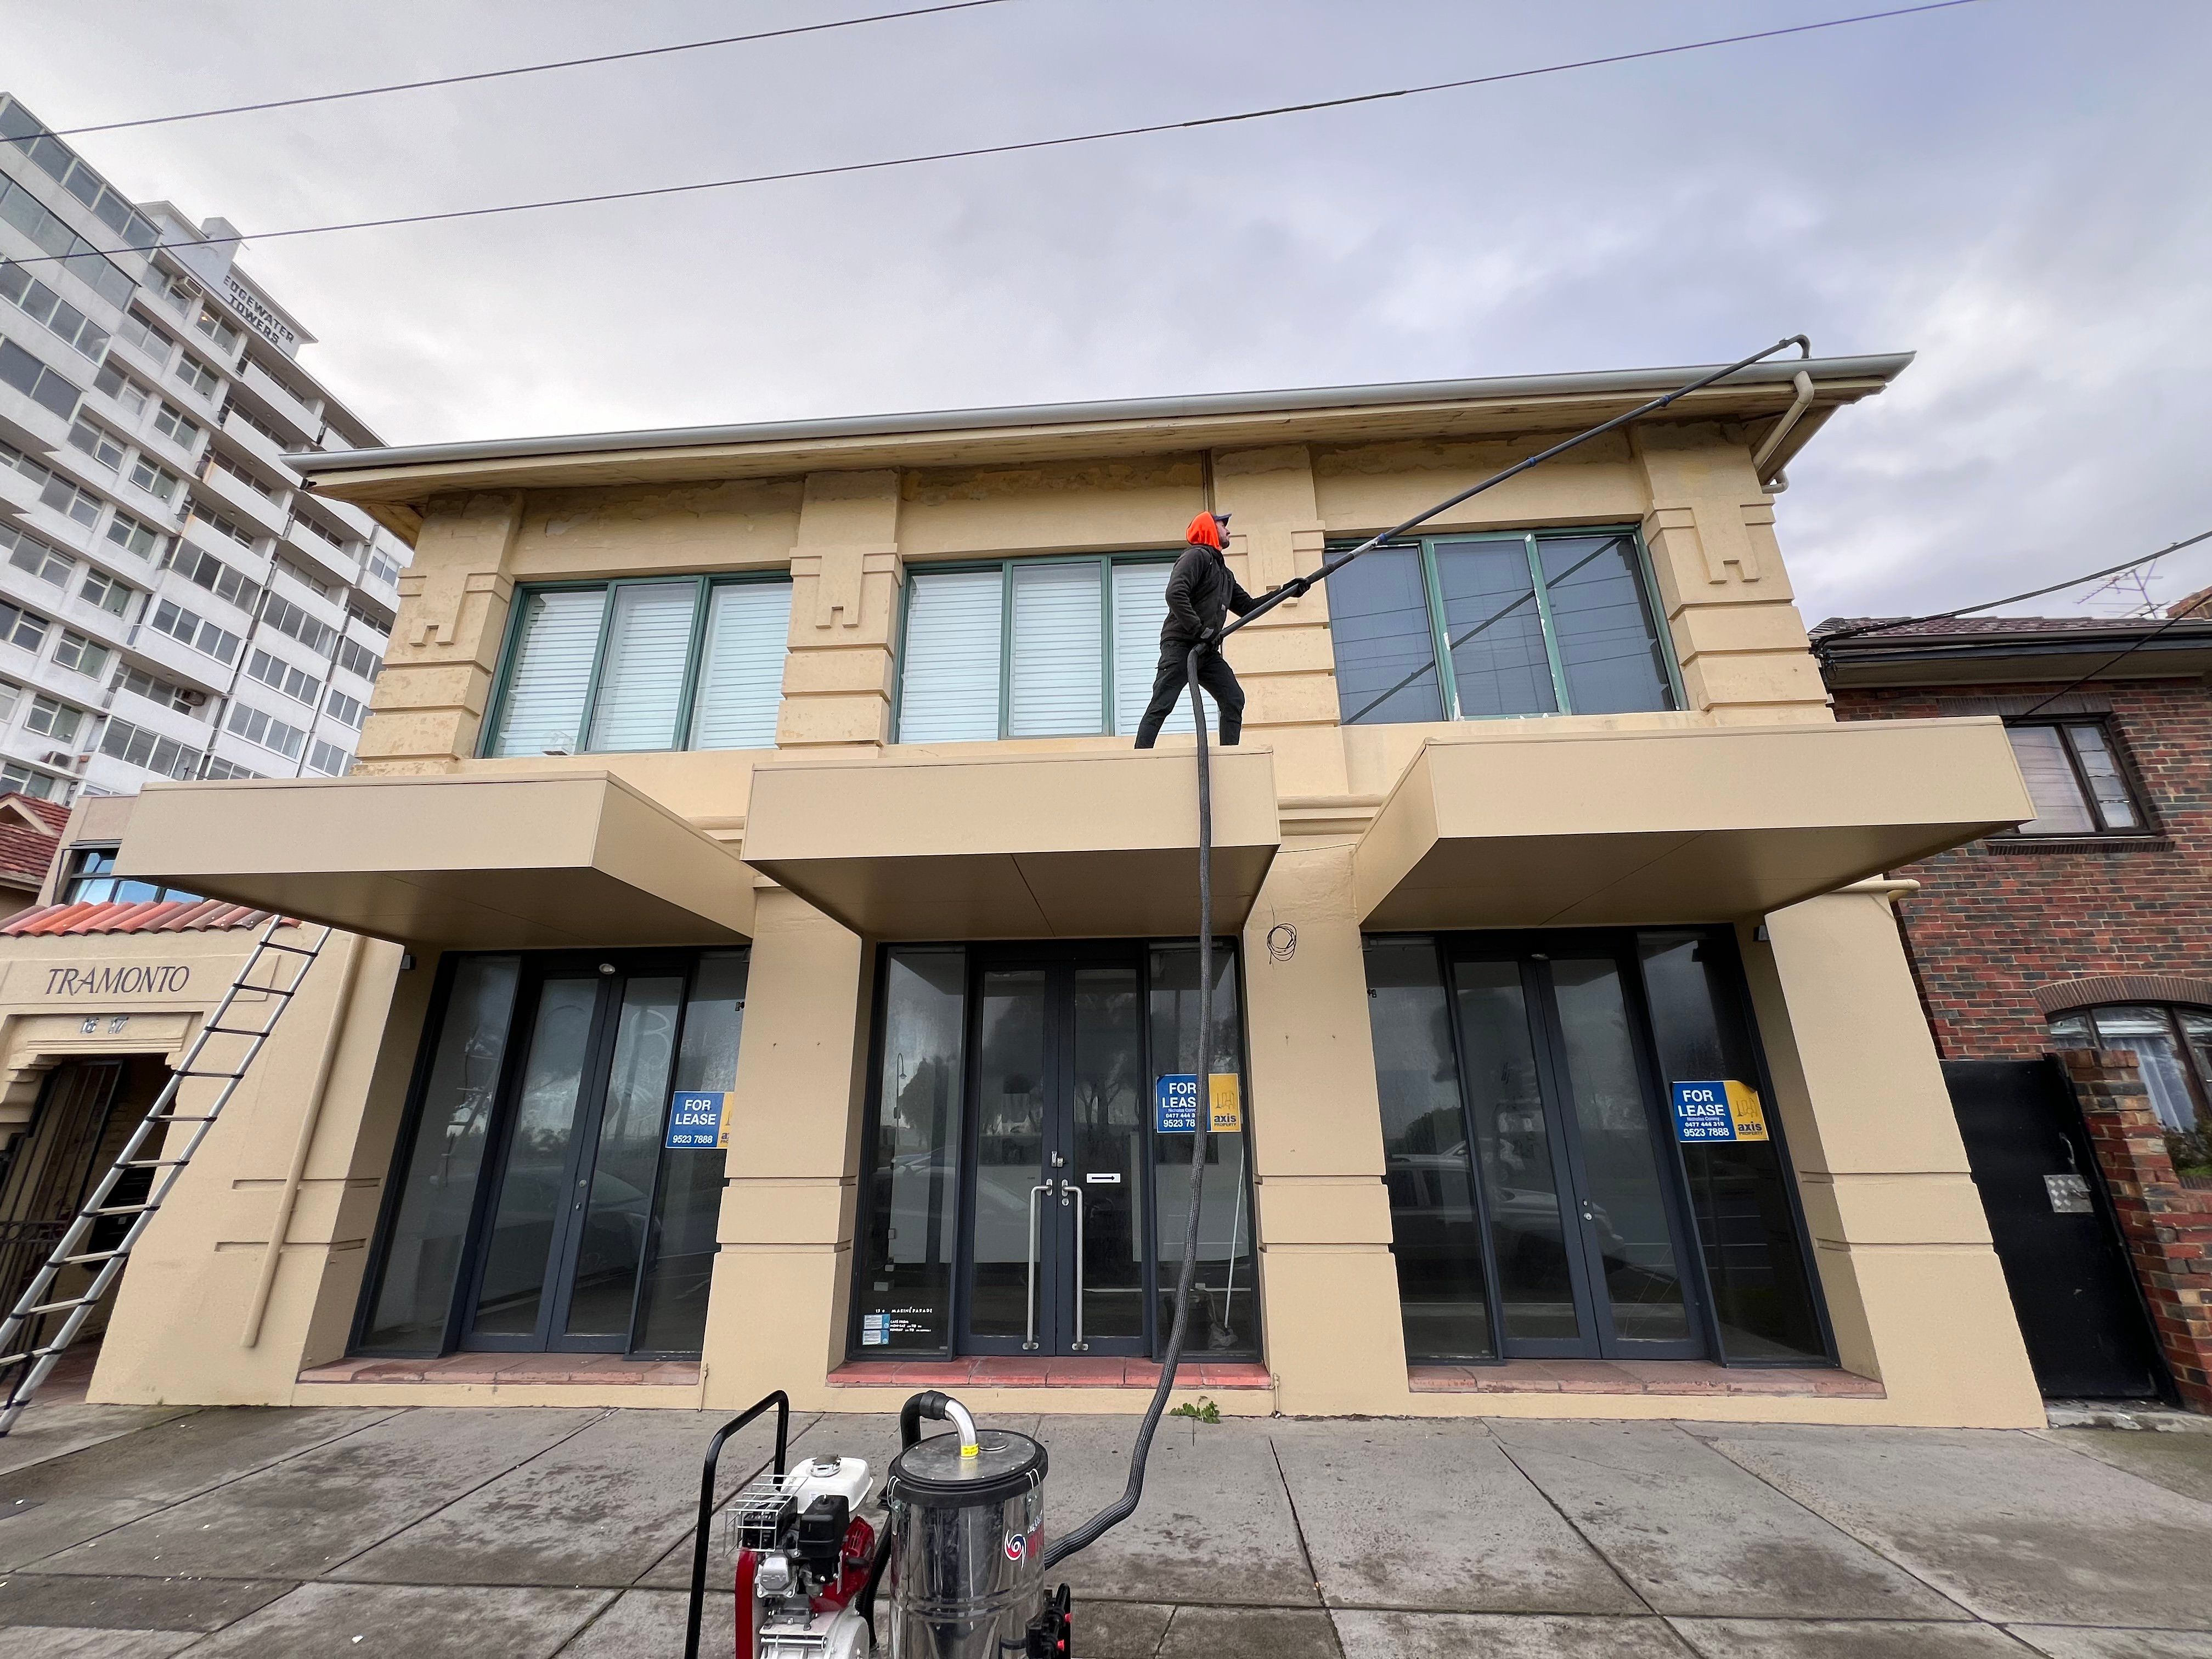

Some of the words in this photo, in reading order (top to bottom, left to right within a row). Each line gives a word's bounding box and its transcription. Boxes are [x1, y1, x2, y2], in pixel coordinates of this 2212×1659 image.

[223, 275, 295, 343] EDGEWATER
[229, 294, 280, 346] TOWERS
[45, 966, 190, 996] TRAMONTO
[1169, 1082, 1197, 1094] FOR
[1683, 1090, 1714, 1102] FOR
[684, 1099, 711, 1111] FOR
[1162, 1097, 1197, 1108] LEAS
[1678, 1104, 1725, 1117] LEASE
[675, 1113, 716, 1125] LEASE
[1163, 1119, 1183, 1127] 9523
[1185, 1119, 1195, 1127] 78
[1214, 1113, 1237, 1122] axis
[1683, 1128, 1706, 1137] 9523
[1707, 1127, 1729, 1136] 7888
[1737, 1121, 1763, 1131] axis
[673, 1135, 691, 1143] 9523
[693, 1135, 713, 1144] 7888
